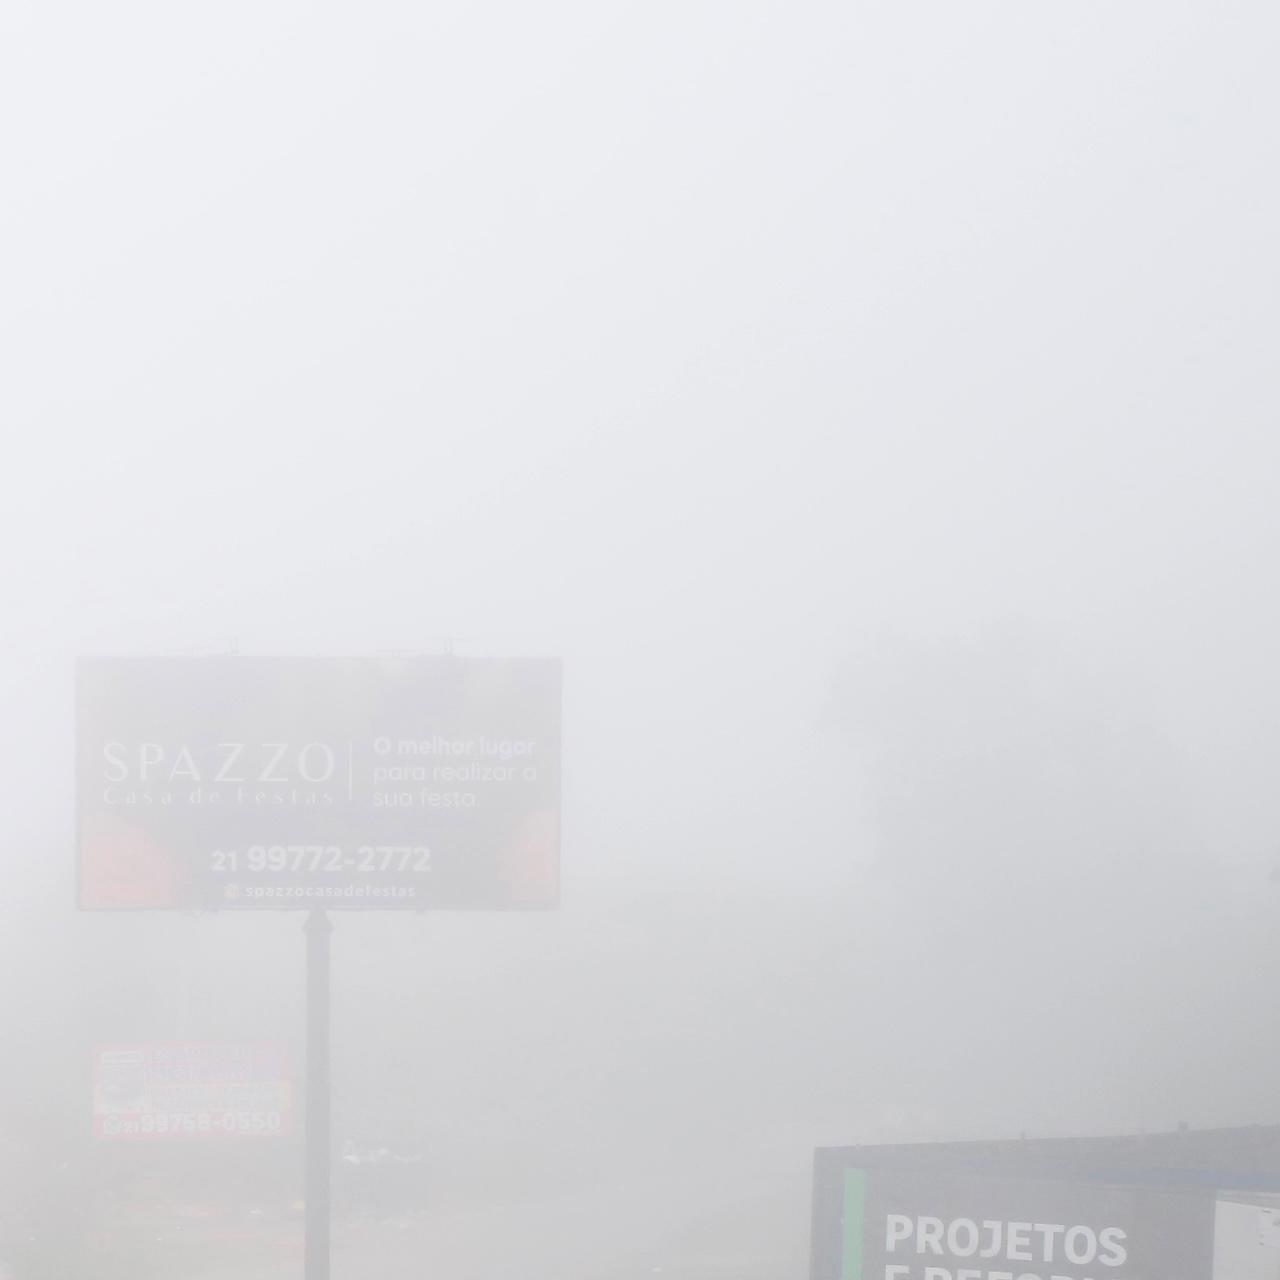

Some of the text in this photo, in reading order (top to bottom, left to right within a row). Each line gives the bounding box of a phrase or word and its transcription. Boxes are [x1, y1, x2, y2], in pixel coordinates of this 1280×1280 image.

[373, 735, 536, 761] O melhor lugar
[103, 741, 336, 783] SPAZZO
[373, 761, 537, 785] para realizar a
[372, 791, 413, 808] sua
[210, 845, 432, 873] 21 99772-2772
[885, 1214, 1128, 1267] PROJETOS
